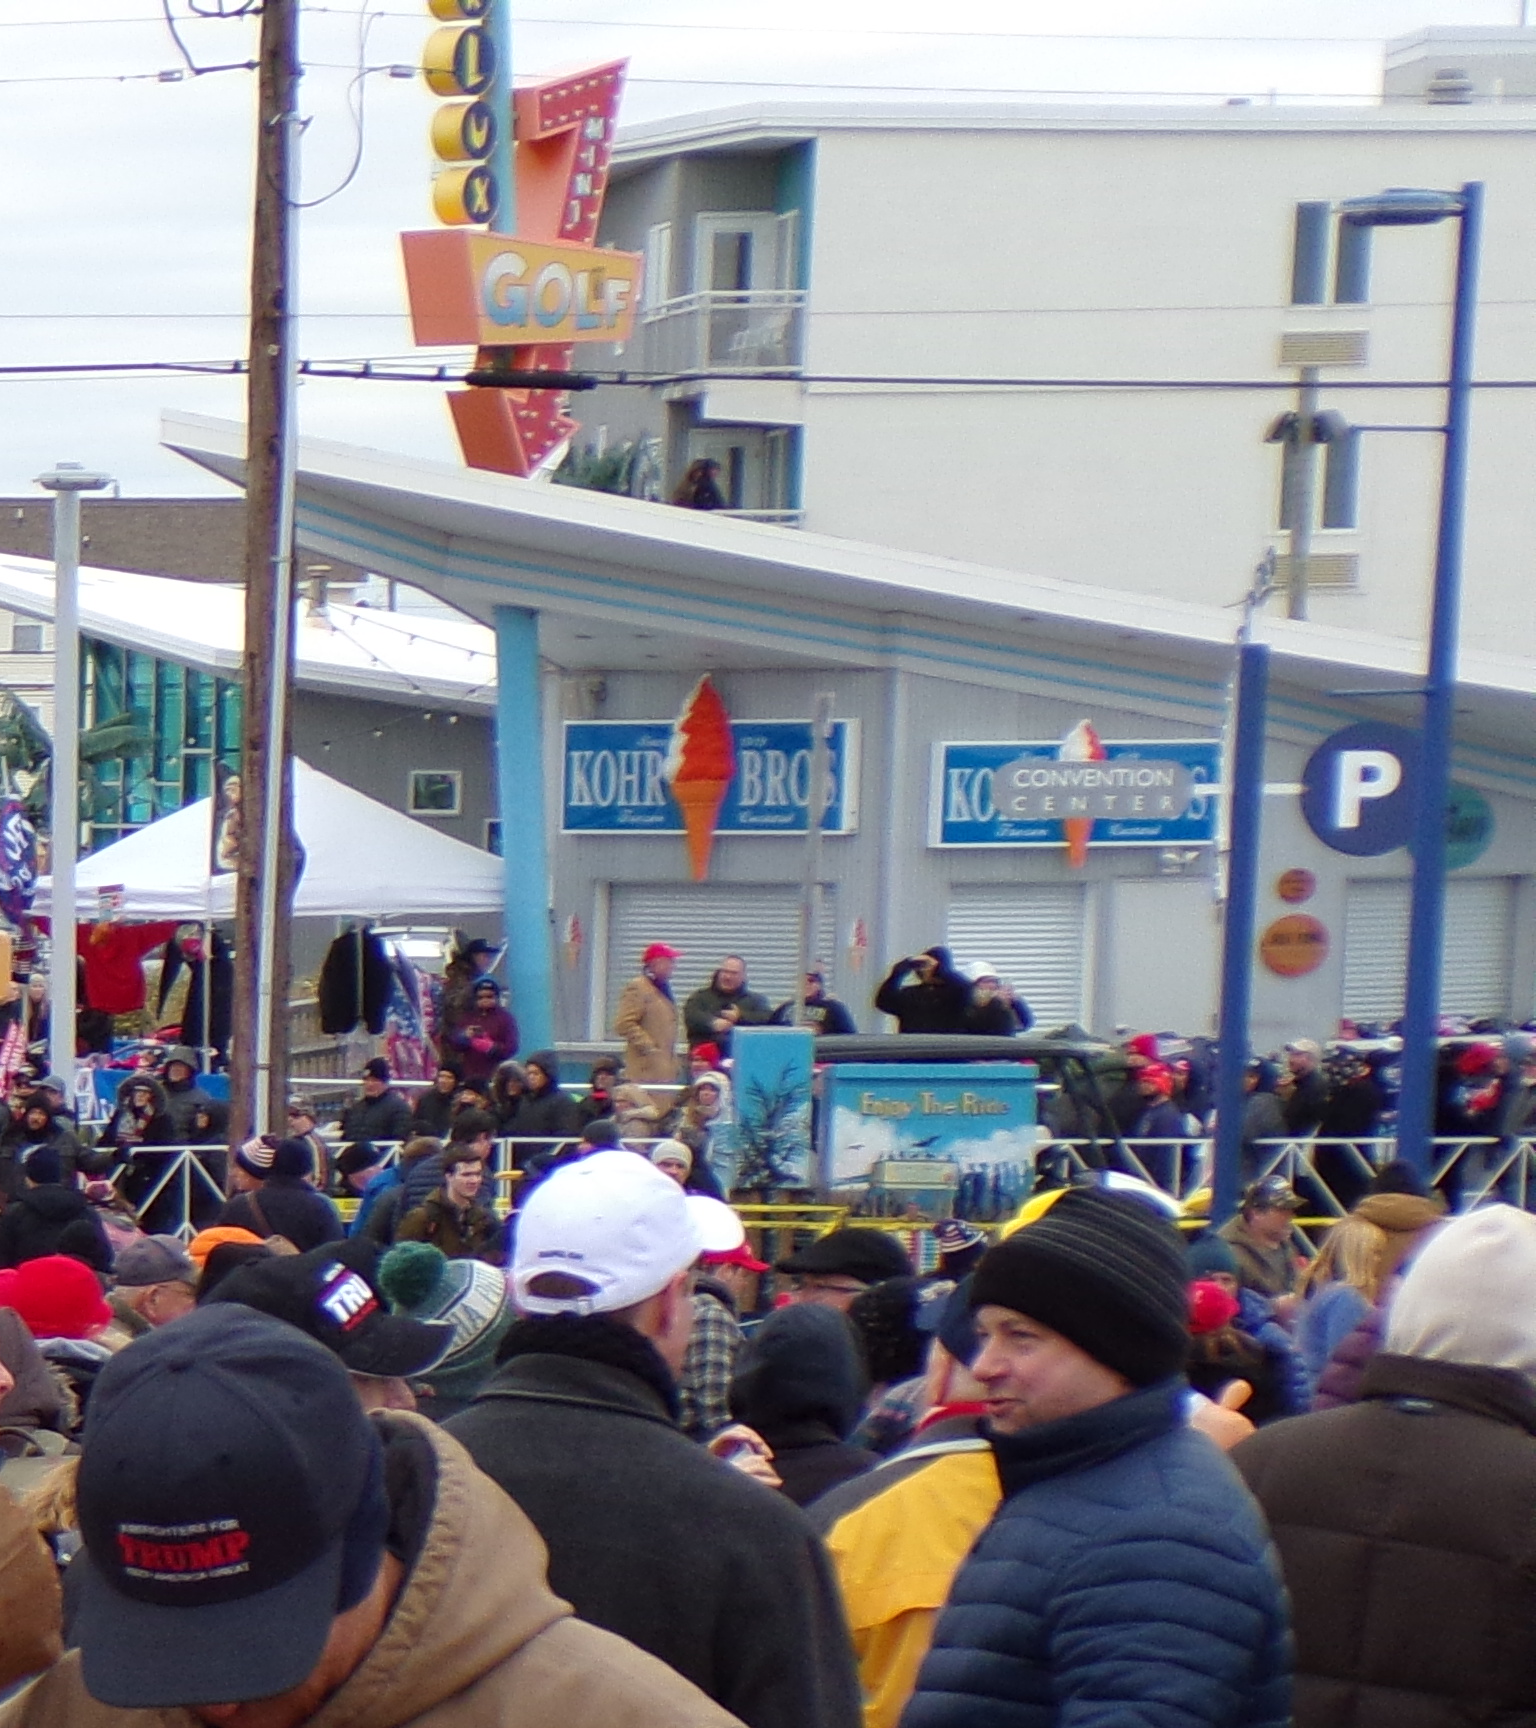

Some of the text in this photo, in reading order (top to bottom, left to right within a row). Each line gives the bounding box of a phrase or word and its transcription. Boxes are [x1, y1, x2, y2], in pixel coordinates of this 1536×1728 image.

[483, 251, 631, 329] GOLF
[569, 751, 666, 806] KOHR
[1013, 769, 1174, 788] CONVENTION
[1337, 751, 1402, 829] P
[1011, 796, 1174, 812] CENTER
[921, 1092, 957, 1115] The
[117, 1529, 250, 1571] TRUMP
